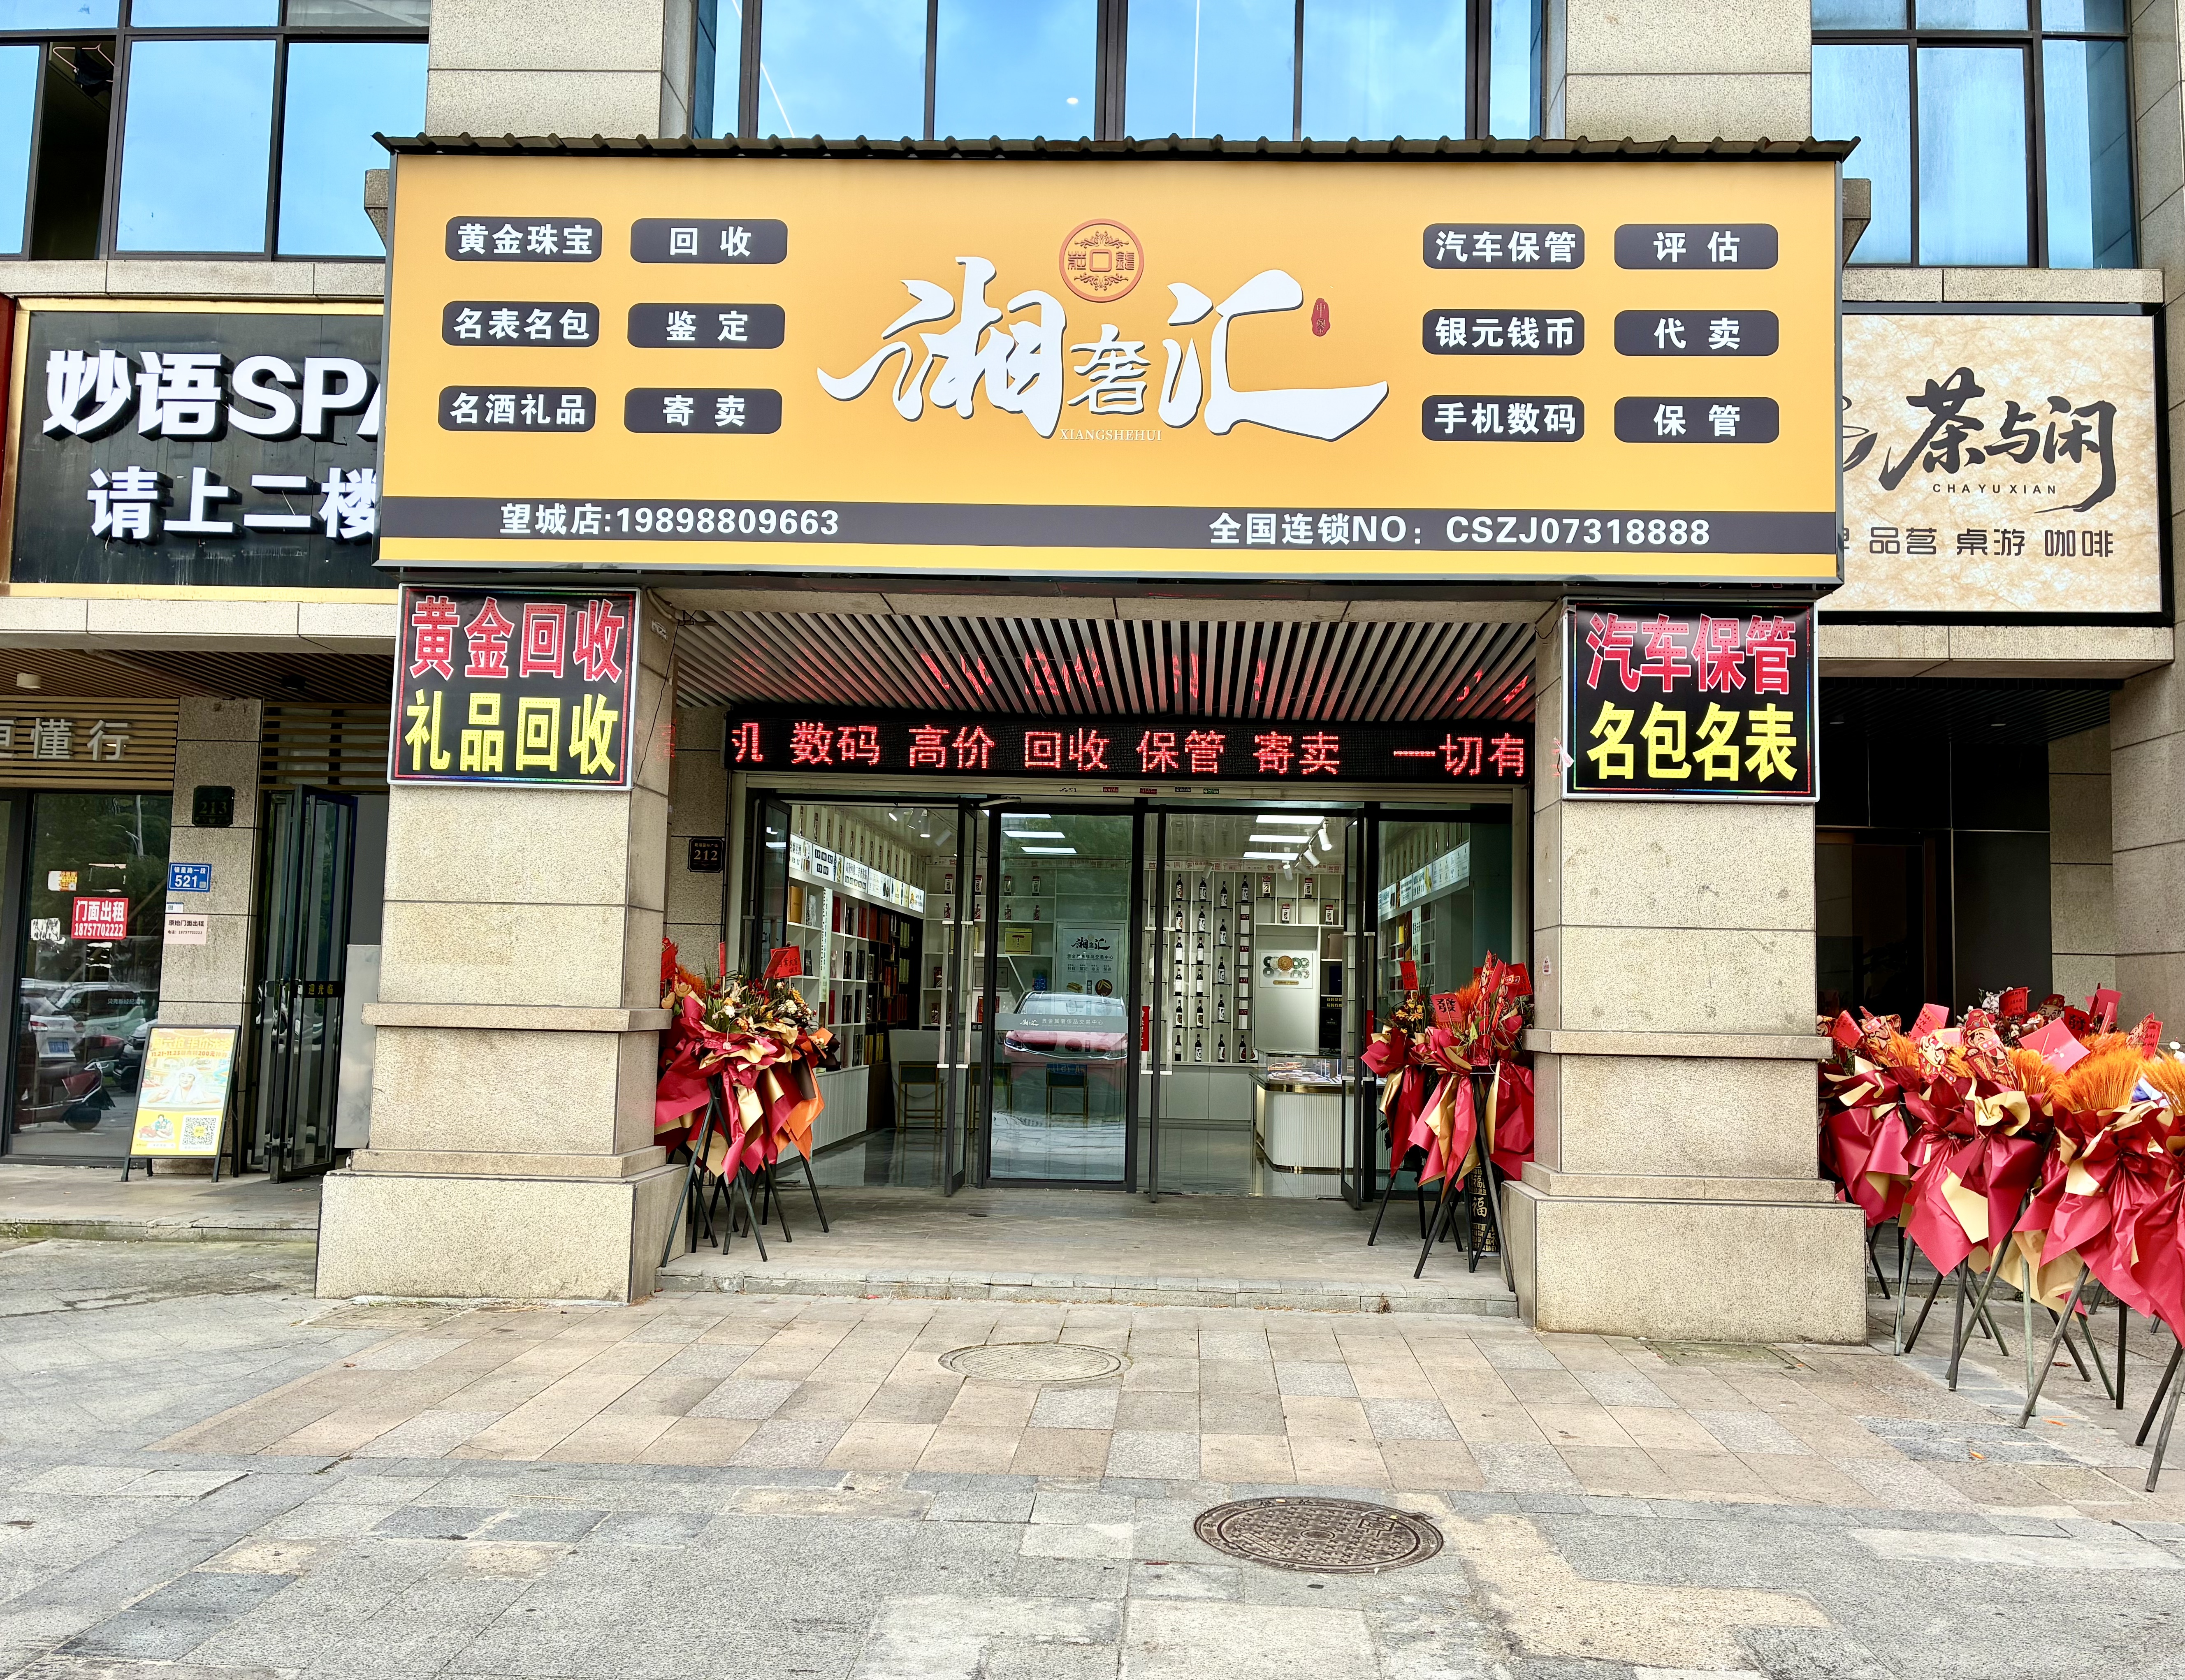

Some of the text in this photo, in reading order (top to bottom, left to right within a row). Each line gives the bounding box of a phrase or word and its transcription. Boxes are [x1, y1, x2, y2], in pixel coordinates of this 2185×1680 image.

[457, 223, 593, 255] 黄金珠宝
[670, 226, 752, 257] 回收
[1436, 231, 1576, 262] 汽车保管
[1654, 232, 1740, 263] 评估
[453, 307, 589, 340] 名表名包
[666, 311, 748, 342] 鉴定
[1435, 316, 1575, 349] 银元钱币
[1654, 317, 1741, 350] 代卖
[816, 256, 1389, 441] 湘奢汇
[42, 349, 381, 436] 妙语SP
[450, 392, 585, 425] 名酒礼品
[662, 395, 745, 427] 寄卖
[1434, 403, 1576, 436] 手机数码
[1654, 403, 1741, 437] 保管
[1060, 429, 1162, 441] XIANGSHEHUI
[1878, 366, 2117, 514] 茶与闲
[87, 466, 376, 539] 请上二楼
[1932, 483, 2056, 494] CHAYUXIAN
[499, 503, 839, 535] 望城店:19898809663
[1870, 527, 1937, 555] 品茗
[1957, 528, 2025, 556] 桌游
[2044, 529, 2113, 557] 咖啡
[409, 595, 624, 683] 黄金回收
[1586, 613, 1796, 694] 汽车保管
[404, 688, 618, 776] 礼品回收
[1586, 700, 1798, 782] 名包名表
[790, 722, 879, 766] 数码
[909, 724, 995, 769] 高价
[1025, 728, 1109, 771] 回收
[1136, 730, 1226, 774] 保管
[1253, 731, 1340, 774] 寄卖
[1393, 733, 1524, 776] 一切有
[199, 802, 227, 814] 213
[694, 850, 718, 860] 212
[174, 875, 197, 888] 521
[75, 900, 124, 922] 门面出租
[74, 923, 123, 936] 18757702222
[1435, 997, 1457, 1013] 發
[1472, 1197, 1487, 1217] 福
